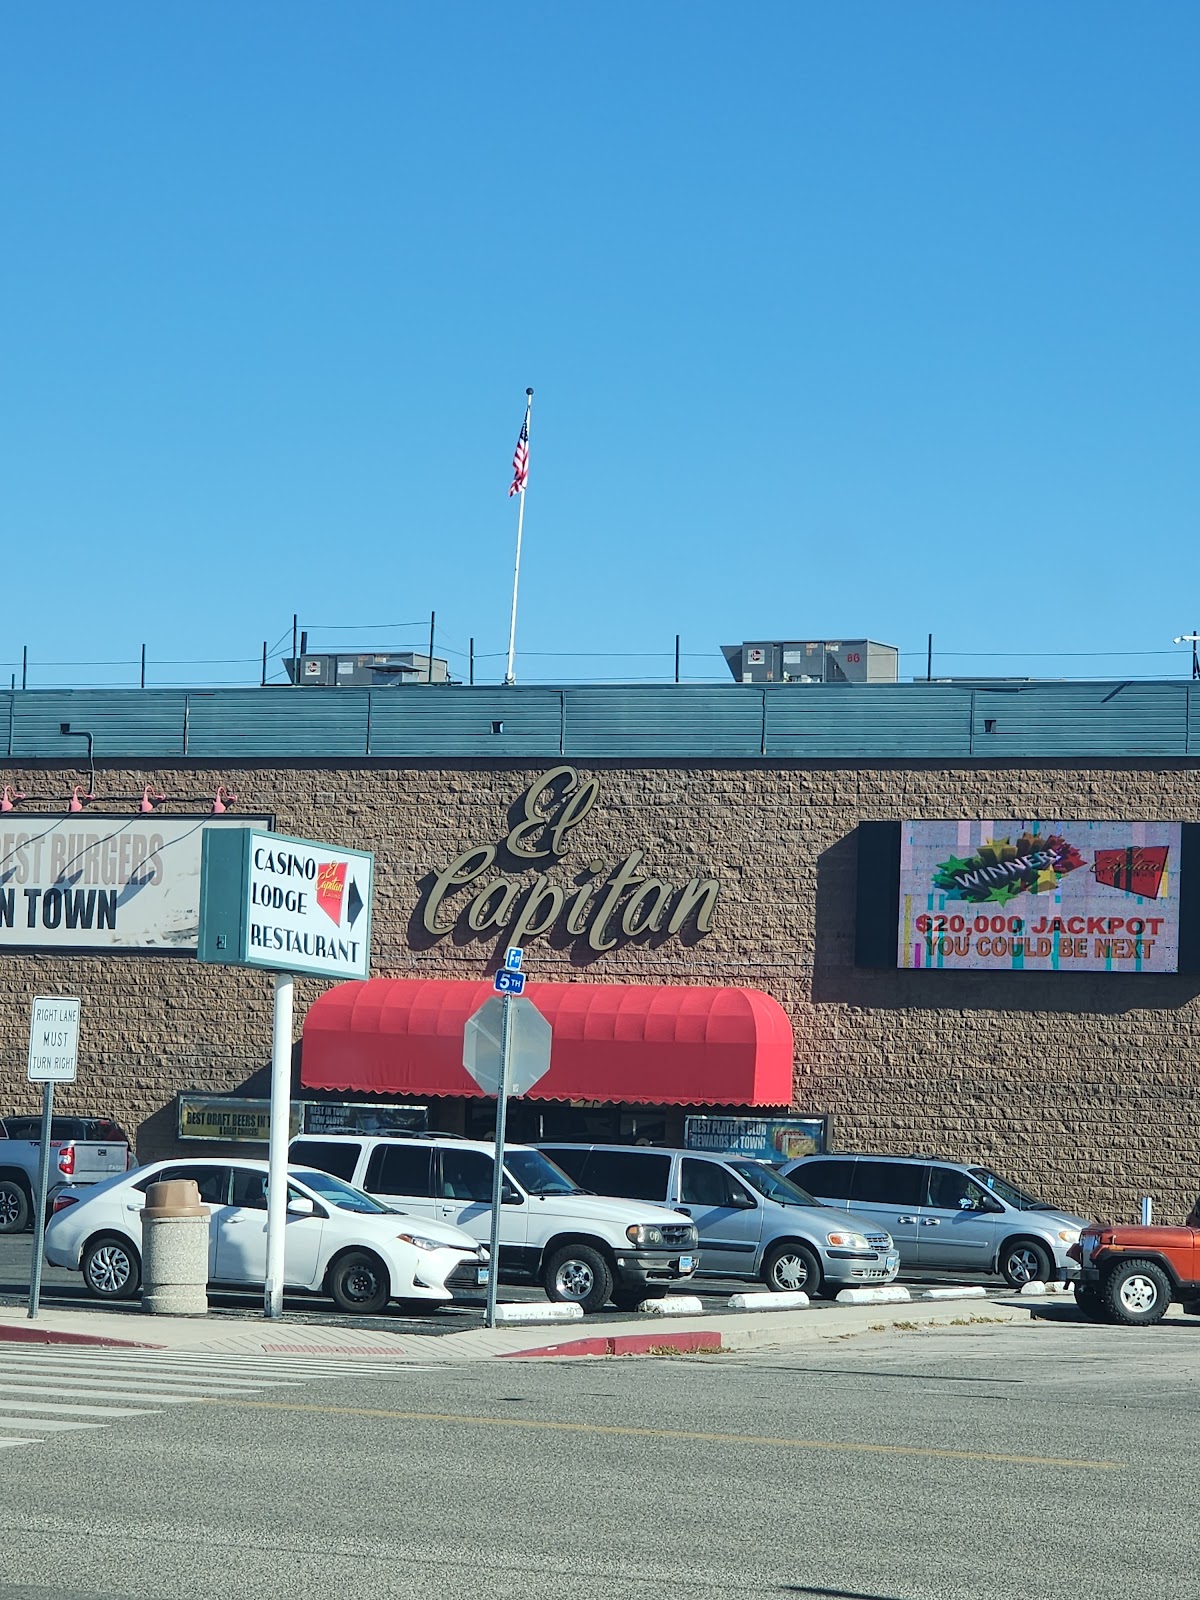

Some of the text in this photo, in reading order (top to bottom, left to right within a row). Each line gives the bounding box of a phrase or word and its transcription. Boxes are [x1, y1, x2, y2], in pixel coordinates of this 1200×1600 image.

[506, 765, 600, 858] El
[0, 832, 164, 886] EST BURGERS
[254, 848, 316, 880] CASINO
[326, 861, 339, 878] El
[954, 847, 1060, 888] WINNER!
[315, 872, 344, 897] Capitan
[0, 888, 118, 930] N TOWN
[252, 881, 308, 915] LODGE
[423, 844, 721, 960] Capitan
[915, 914, 1165, 936] $20,000 JACKPOT
[251, 923, 361, 963] RESTAURANT
[924, 936, 1156, 959] YOU COULD BE NEXT
[508, 950, 516, 966] F
[500, 973, 521, 989] 5TH
[36, 1009, 77, 1022] RIGHT LANE
[43, 1031, 68, 1047] MUST
[32, 1056, 74, 1069] TURN RIGHT
[187, 1112, 206, 1125] BEST
[207, 1113, 231, 1126] DRAFT
[232, 1114, 256, 1127] BEERS
[257, 1115, 265, 1128] IN
[310, 1106, 325, 1115] BEST
[692, 1120, 767, 1136] BEST PLAYER'S CLUB
[691, 1134, 729, 1148] REWARDS
[730, 1135, 738, 1149] IN
[740, 1136, 766, 1150] TOWN!
